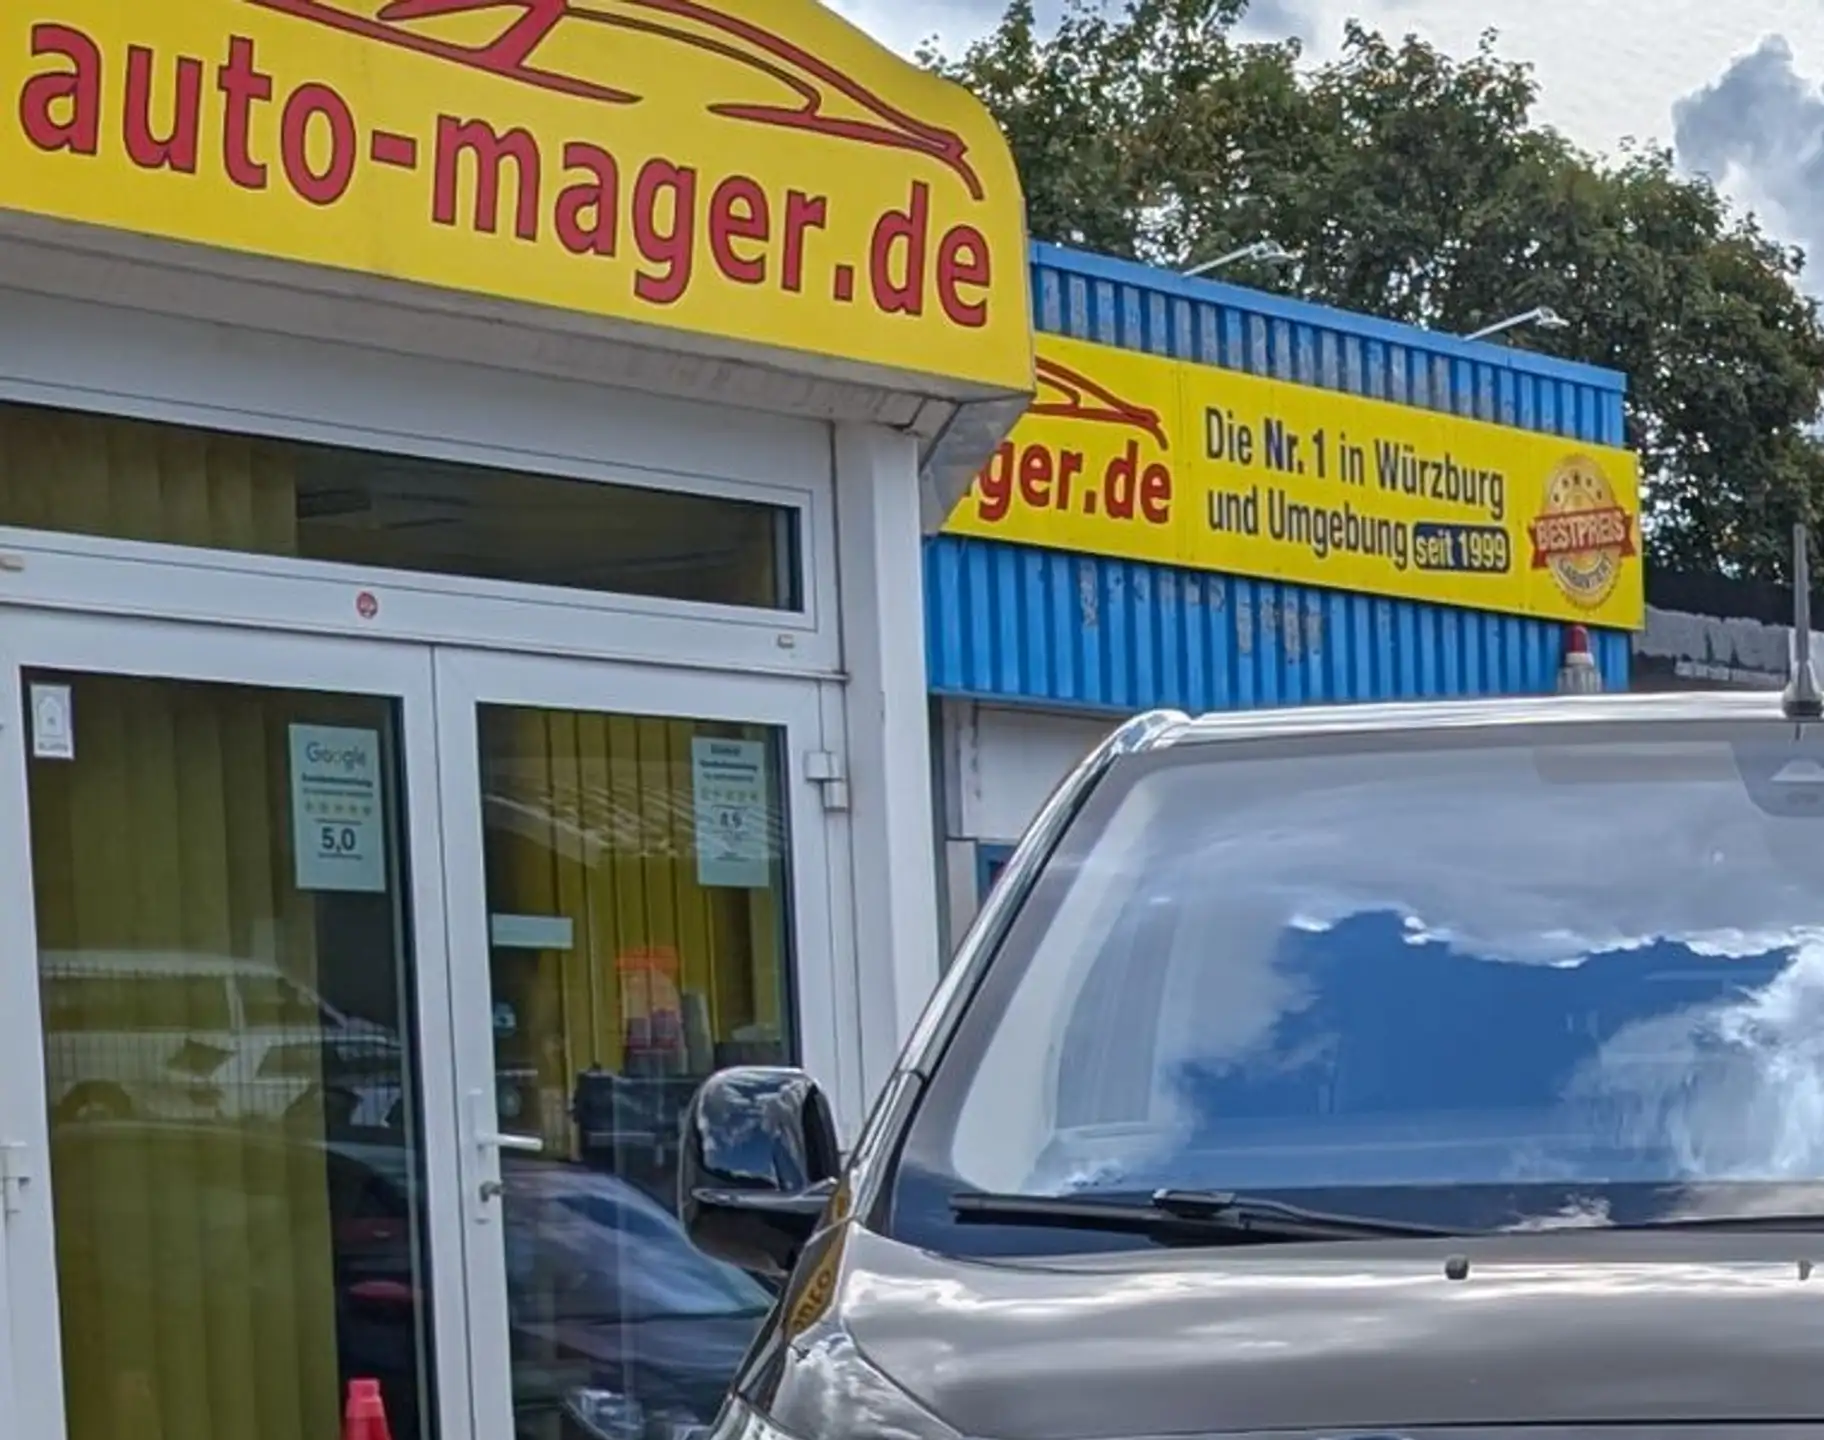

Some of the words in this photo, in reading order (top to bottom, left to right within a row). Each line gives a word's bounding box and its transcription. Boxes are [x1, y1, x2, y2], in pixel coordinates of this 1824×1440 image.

[18, 23, 991, 328] auto-mager.de
[963, 439, 1171, 523] ger.de
[1205, 406, 1252, 465] Die
[1264, 417, 1303, 475] Nr.
[1312, 428, 1325, 479] 1
[1340, 431, 1365, 487] in
[1374, 438, 1504, 521] Würzburg
[1208, 485, 1259, 536] und
[1268, 487, 1408, 571] Umgebung
[1416, 529, 1455, 567] seit
[1459, 530, 1506, 570] 1999
[1535, 509, 1626, 552] BESTPREIS
[305, 740, 367, 772] Google
[321, 826, 356, 853] 5,0
